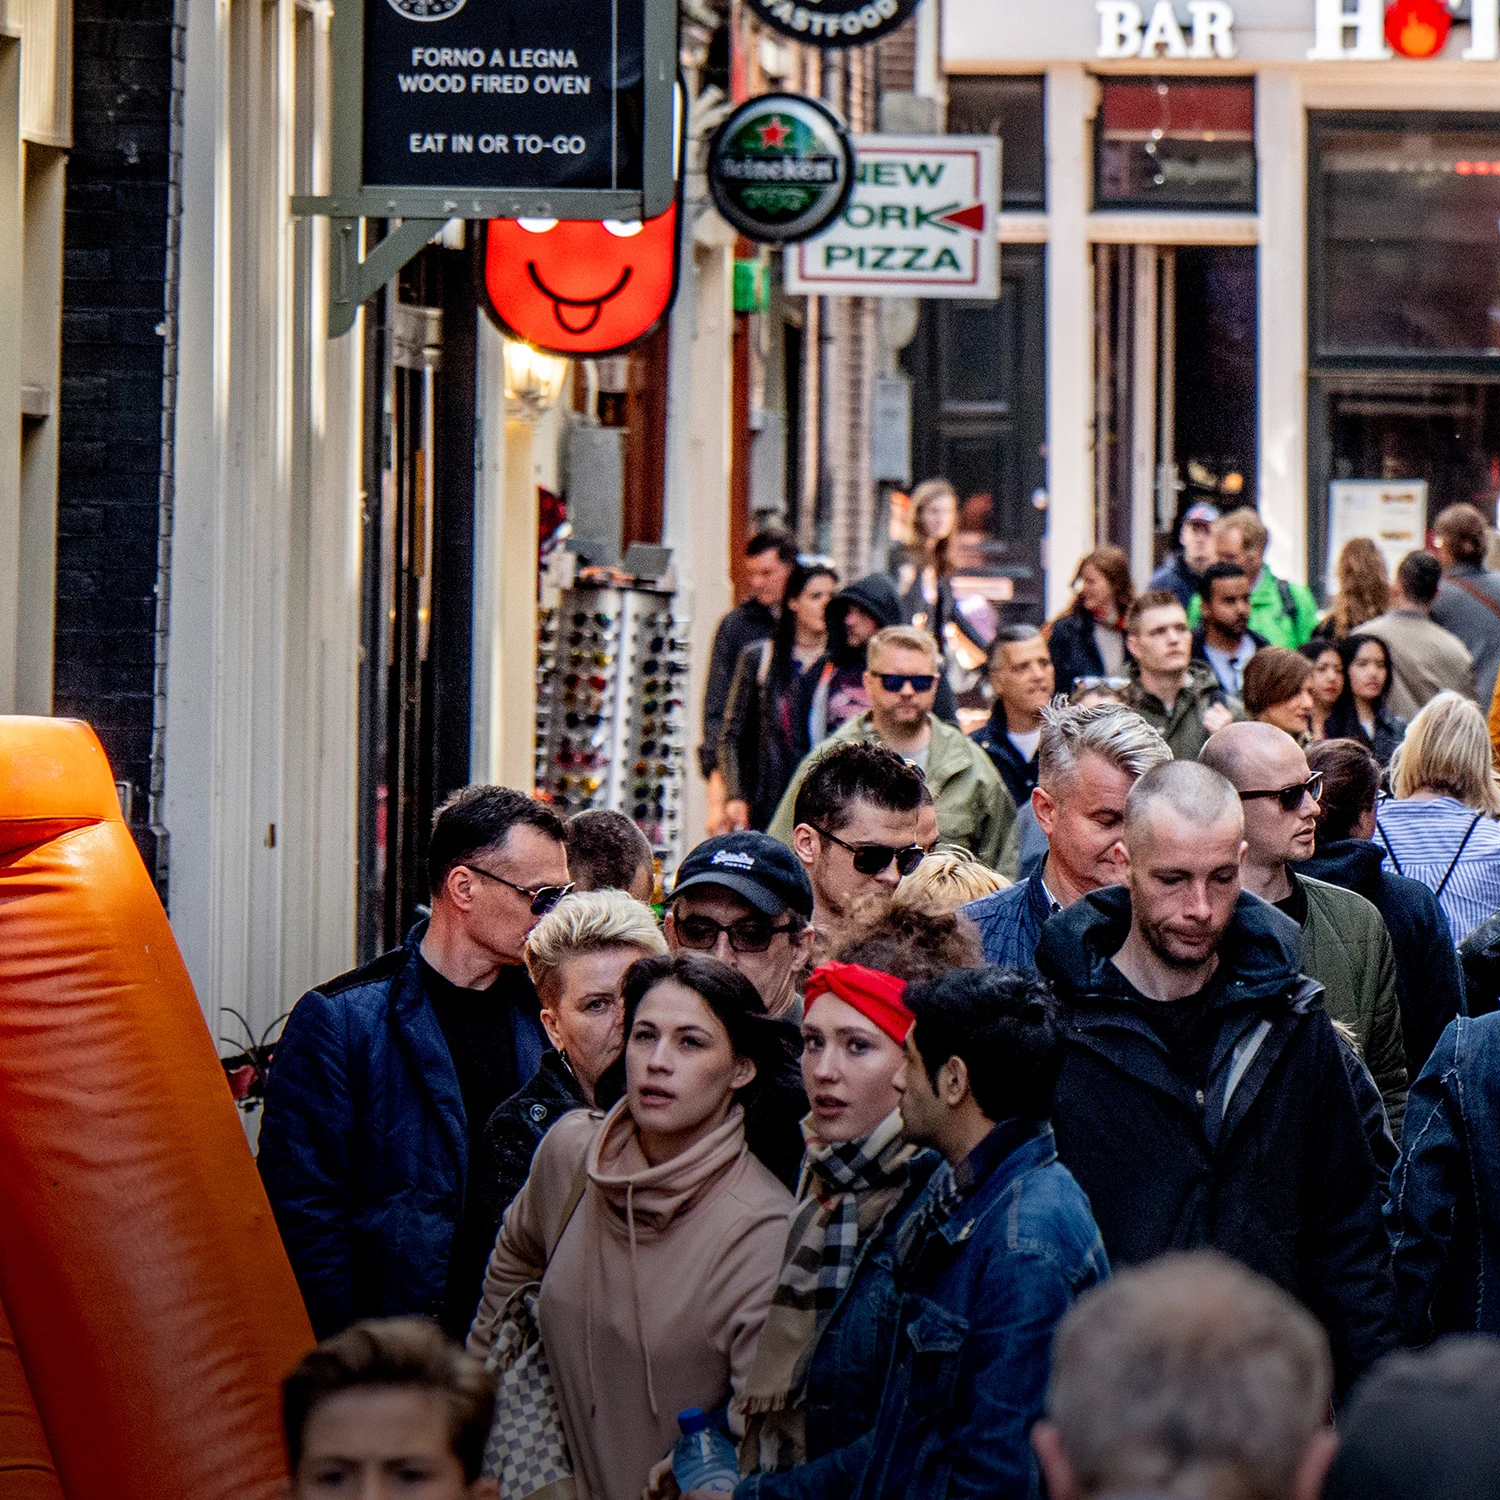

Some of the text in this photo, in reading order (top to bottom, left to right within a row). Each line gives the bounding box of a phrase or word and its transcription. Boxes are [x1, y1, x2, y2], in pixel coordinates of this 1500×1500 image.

[1095, 0, 1238, 59] BAR
[411, 47, 579, 69] FORNO A LEGNA
[398, 74, 592, 95] WOOD FIRED OVEN
[408, 133, 586, 155] EAT IN OR TO-GO
[845, 203, 960, 233] ORK
[823, 245, 961, 272] PIZZA
